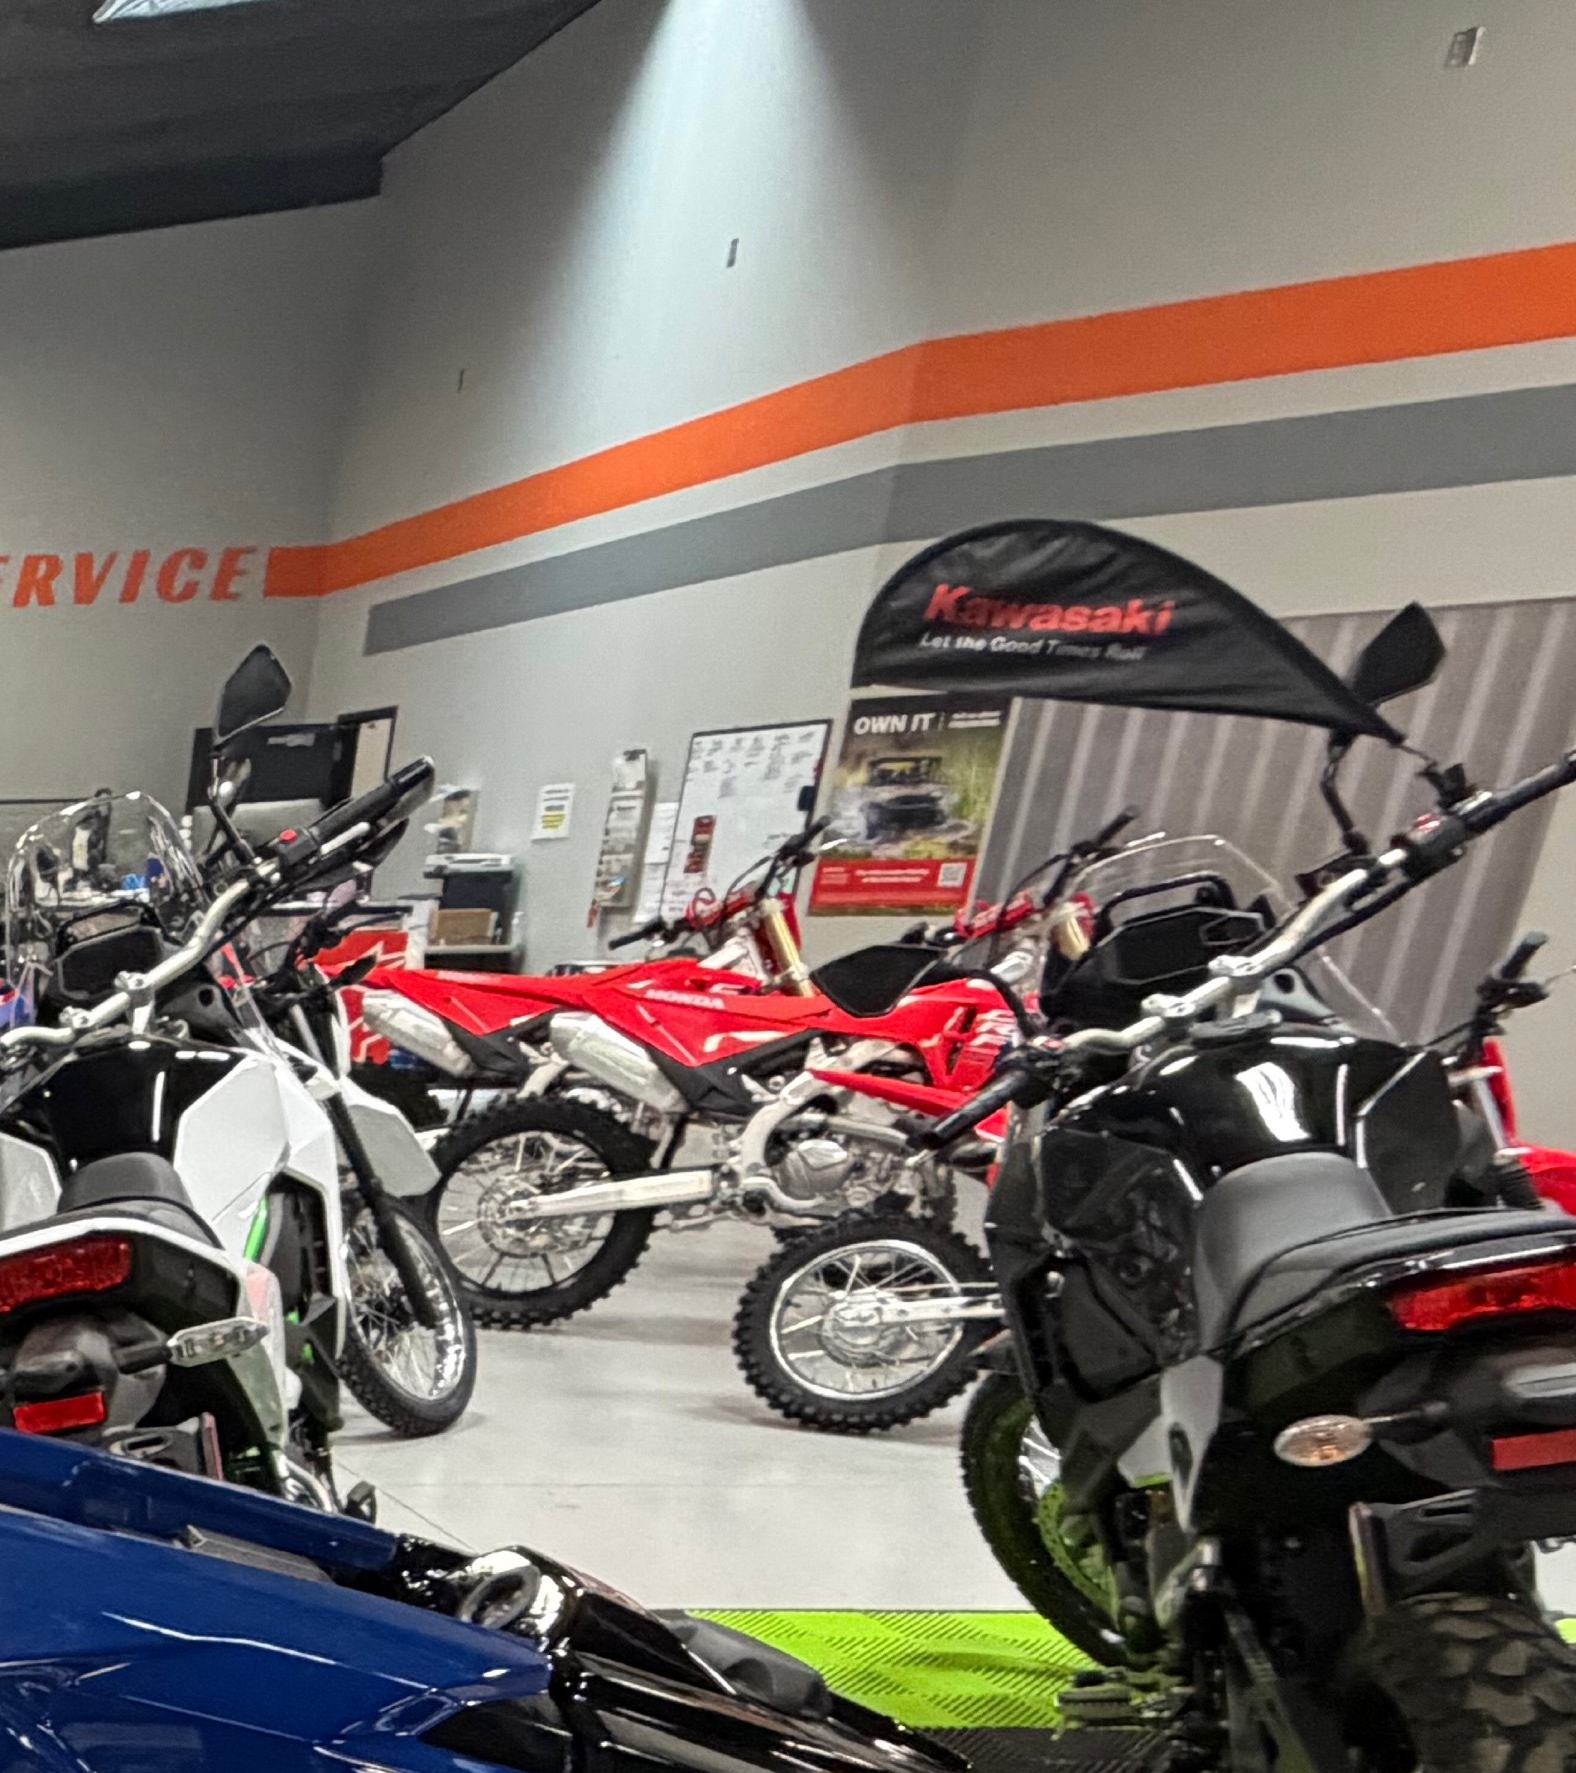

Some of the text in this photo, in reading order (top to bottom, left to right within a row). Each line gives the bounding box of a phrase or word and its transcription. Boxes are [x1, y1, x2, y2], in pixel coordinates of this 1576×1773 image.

[923, 583, 1176, 635] Kawasaki
[920, 632, 1147, 661] Let the Good Times Roll
[853, 712, 907, 735] OWN
[911, 712, 936, 731] IT
[644, 988, 726, 1010] HONDA
